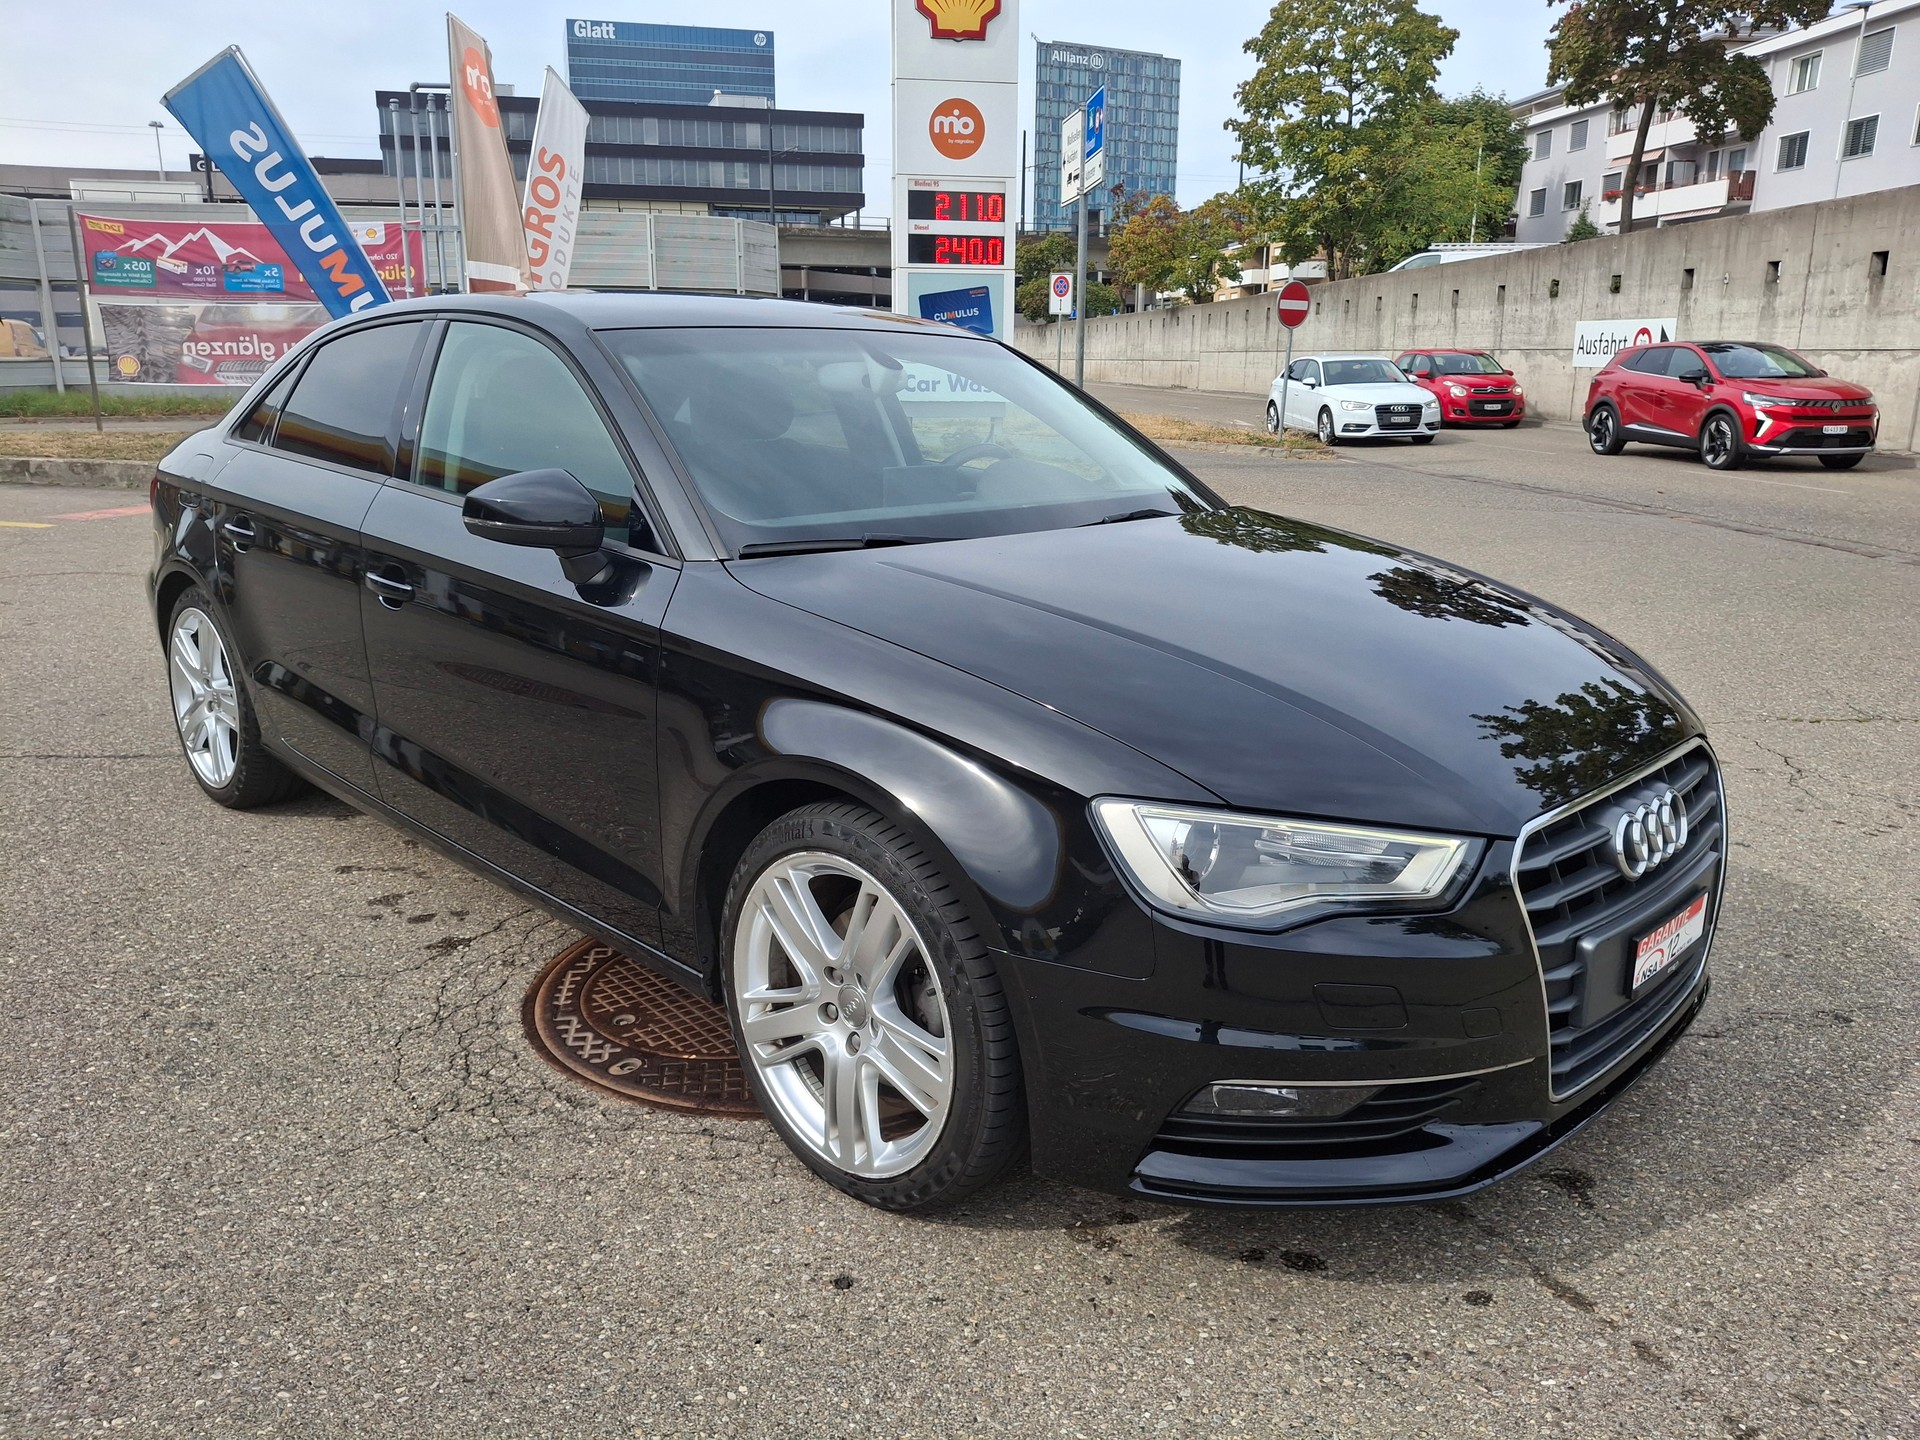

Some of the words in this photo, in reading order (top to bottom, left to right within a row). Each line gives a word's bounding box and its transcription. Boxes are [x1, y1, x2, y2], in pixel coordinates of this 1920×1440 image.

[574, 20, 616, 39] Glatt
[755, 32, 766, 47] hp
[1052, 50, 1088, 66] Allianz
[934, 109, 975, 135] mio
[935, 193, 1002, 221] 211.0
[935, 236, 1002, 264] 240.0
[934, 307, 979, 321] CUMULUS
[1577, 332, 1628, 355] Ausfahrt
[904, 374, 940, 393] Car
[1638, 906, 1691, 956] GARANTIE
[1666, 932, 1680, 962] 12
[1640, 961, 1658, 982] NSA
